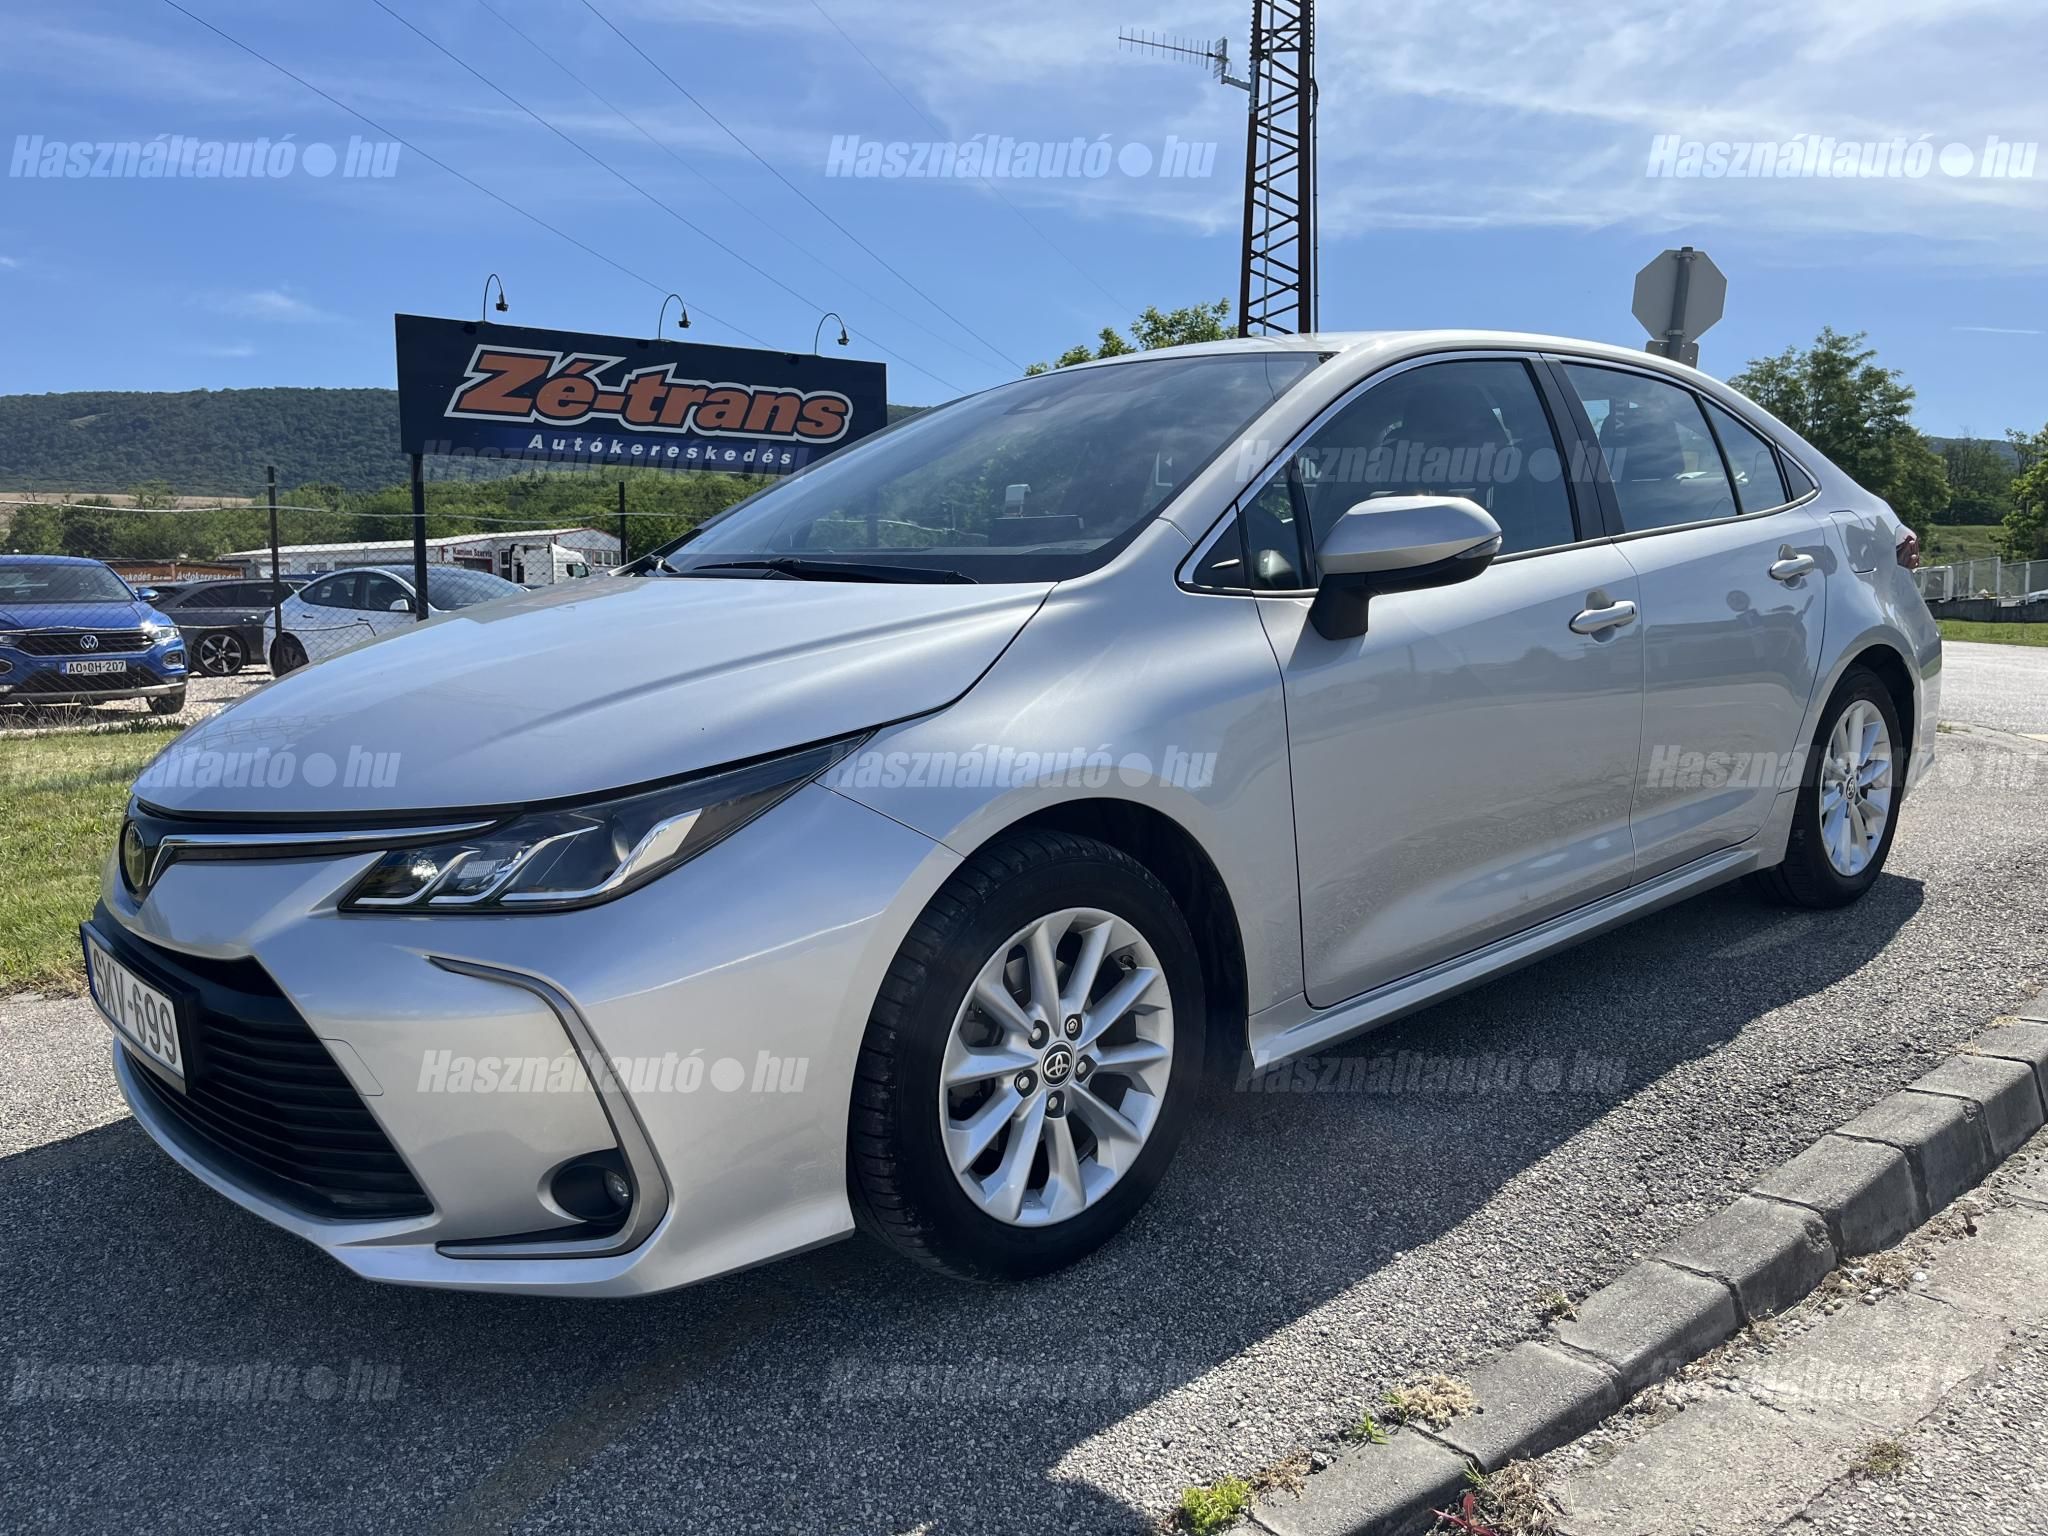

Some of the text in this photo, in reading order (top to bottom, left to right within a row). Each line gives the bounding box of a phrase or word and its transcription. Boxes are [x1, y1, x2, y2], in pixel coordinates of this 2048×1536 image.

[444, 344, 853, 443] Zé-trans
[528, 433, 792, 465] Autókereskedés
[94, 948, 176, 1065] SKV-699
